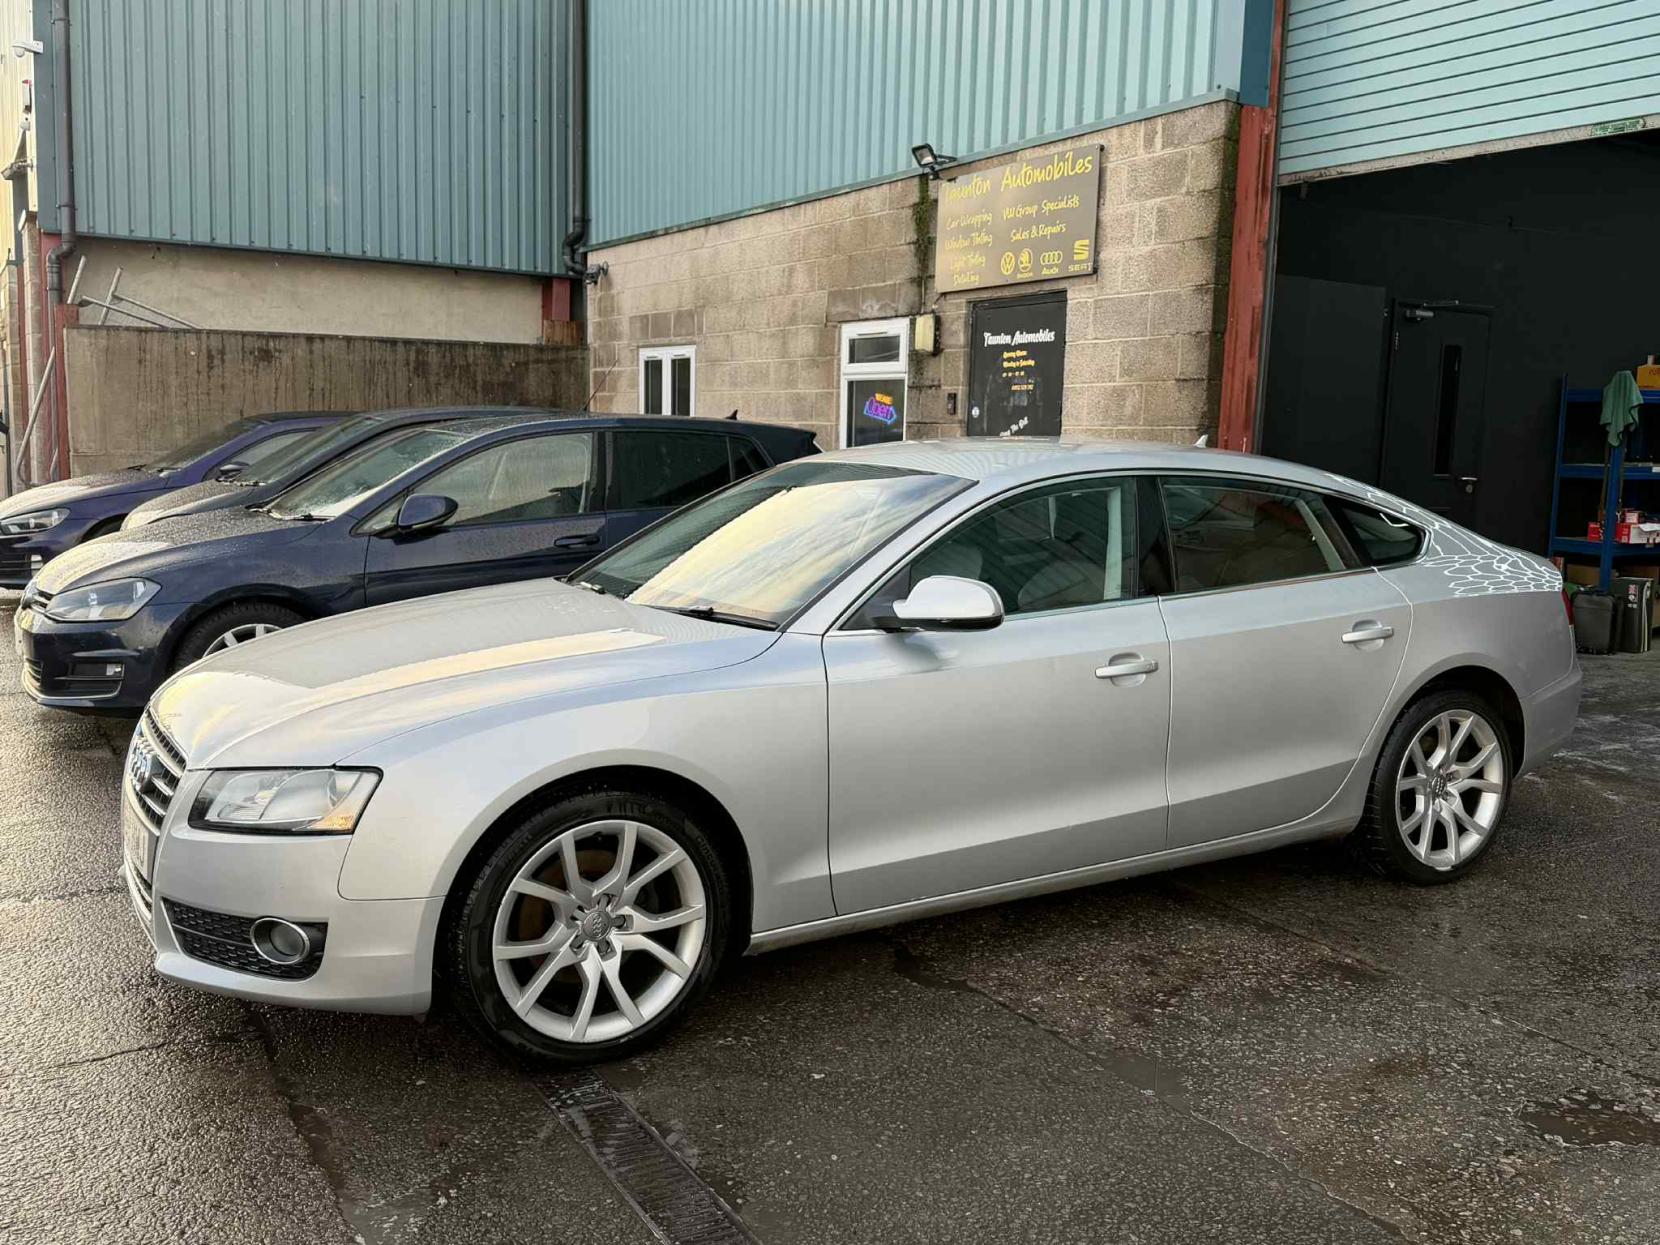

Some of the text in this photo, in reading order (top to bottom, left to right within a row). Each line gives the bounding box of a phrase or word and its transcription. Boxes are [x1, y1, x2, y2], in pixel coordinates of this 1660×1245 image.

[1001, 151, 1093, 192] Automobiles
[1041, 194, 1080, 216] Specialists
[1039, 220, 1066, 240] Repairs
[1068, 262, 1093, 272] SEAT
[983, 328, 1056, 347] Taunton Automobiles
